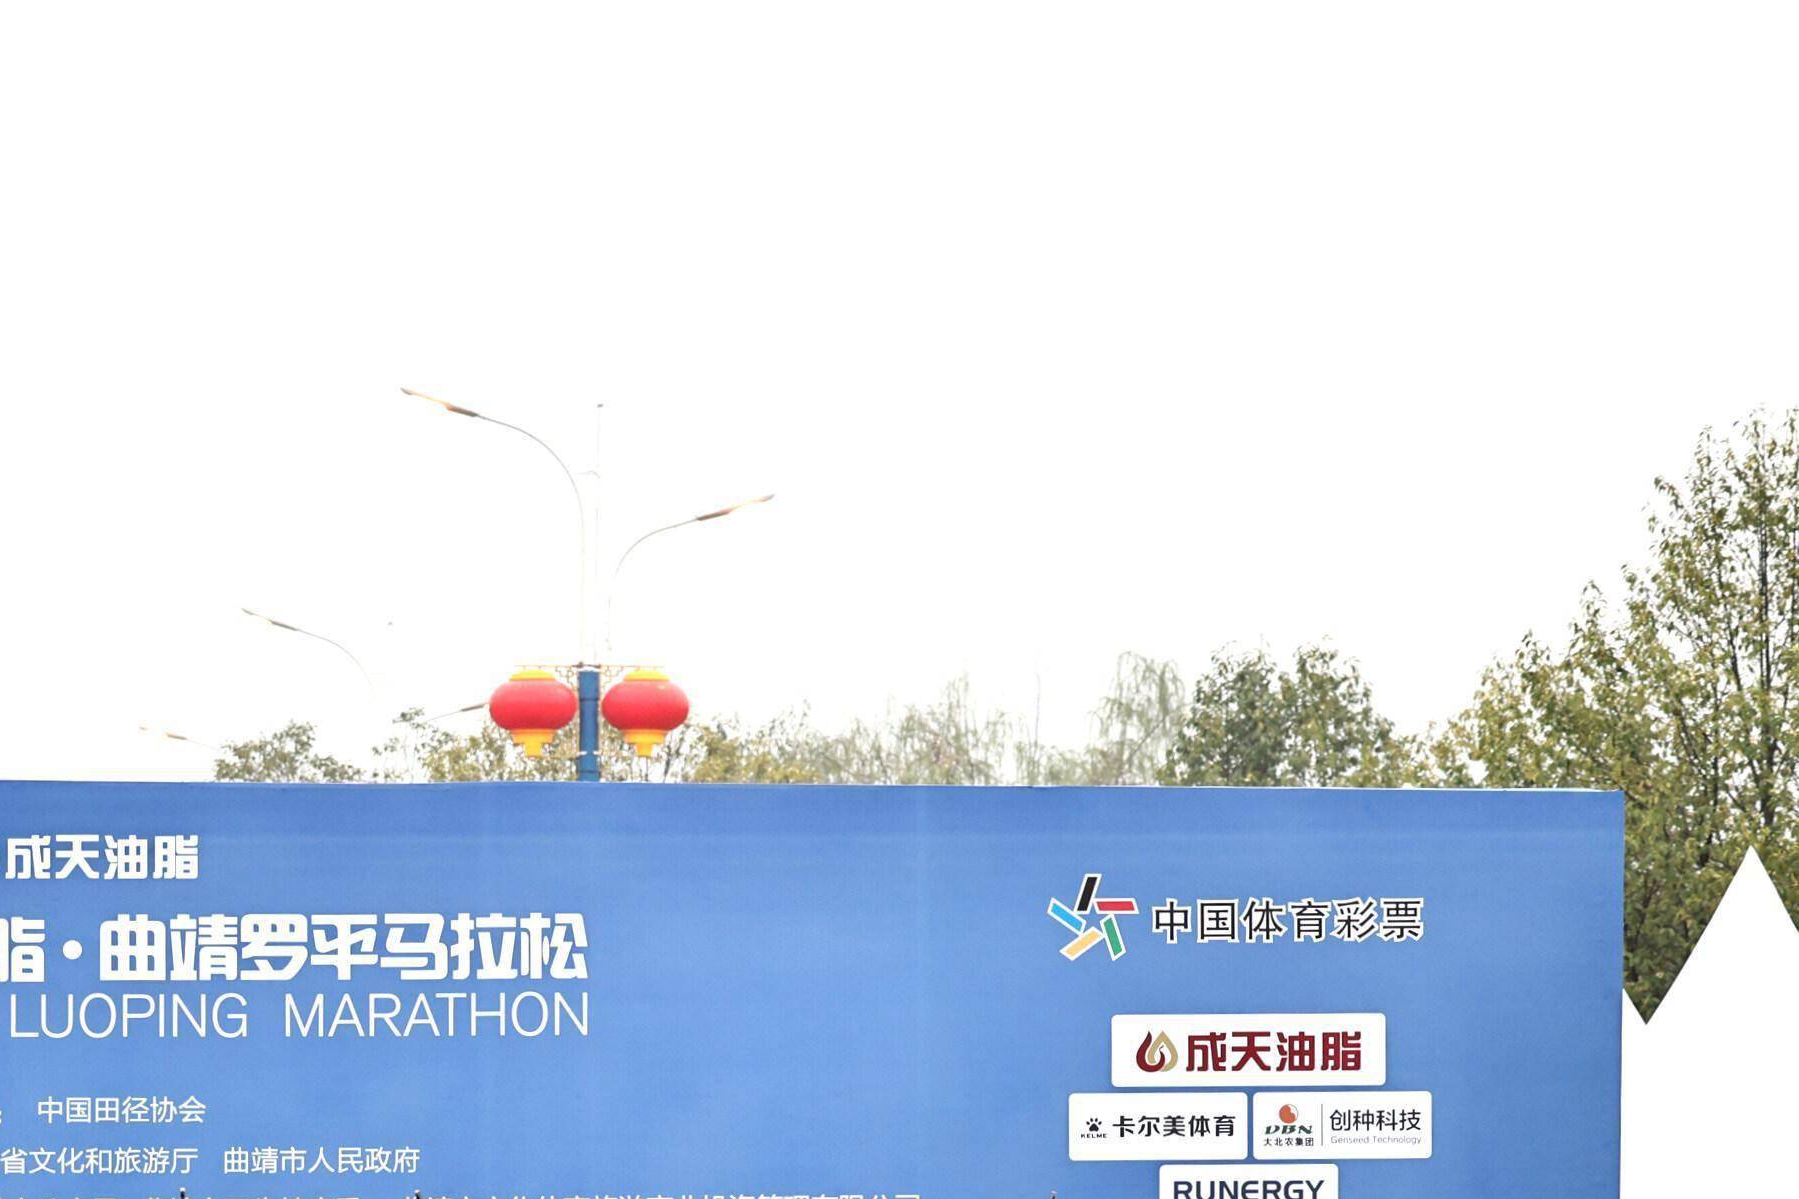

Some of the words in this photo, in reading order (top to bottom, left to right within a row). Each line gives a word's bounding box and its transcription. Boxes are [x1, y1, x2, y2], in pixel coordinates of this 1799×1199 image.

[4, 834, 199, 880] 成天油脂
[1152, 897, 1424, 944] 中国体育彩票
[10, 992, 248, 1039] LUOPING
[285, 991, 589, 1038] MARATHON
[1186, 1031, 1362, 1072] 成天油脂
[37, 1095, 206, 1124] 中国田径协会
[1329, 1109, 1422, 1131] 创种科技
[1112, 1114, 1236, 1138] 卡尔美体育
[1264, 1124, 1314, 1135] DBN
[1264, 1137, 1315, 1147] 大北农集团
[1373, 1135, 1422, 1146] Technology
[224, 1146, 420, 1174] 曲靖市人民政府
